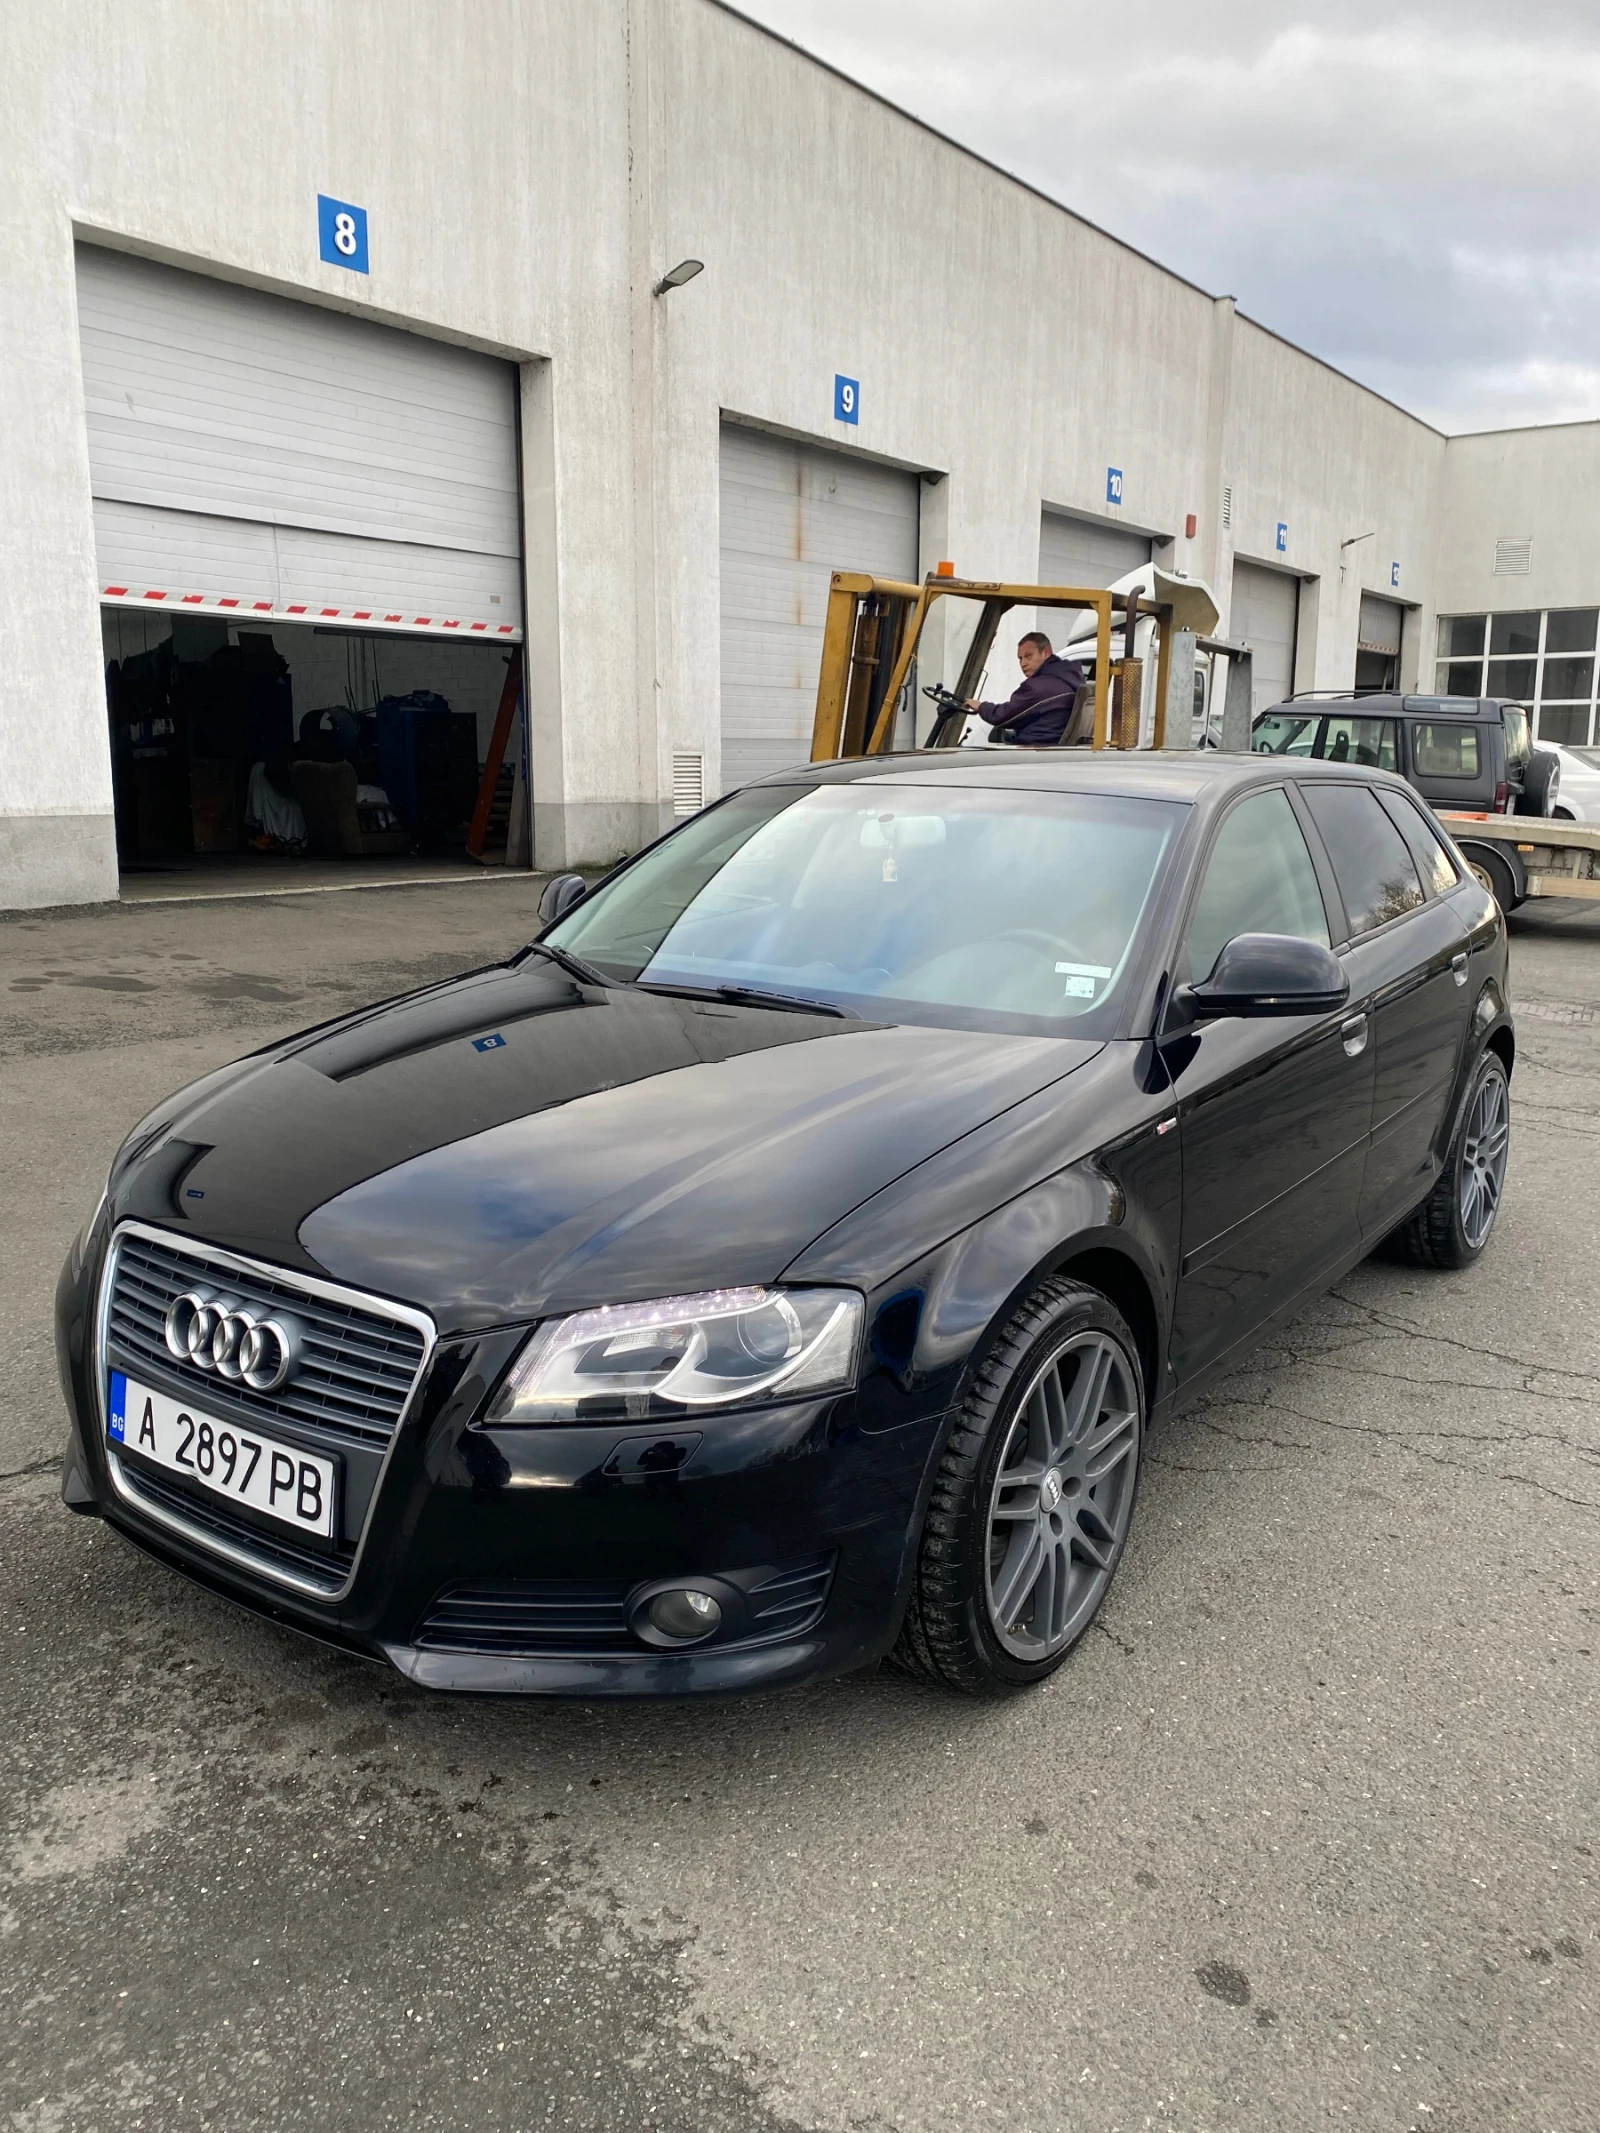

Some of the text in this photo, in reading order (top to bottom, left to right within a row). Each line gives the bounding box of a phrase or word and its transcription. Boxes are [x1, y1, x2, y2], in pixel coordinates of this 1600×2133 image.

[335, 212, 357, 256] 8
[842, 384, 855, 414] 9
[1110, 474, 1122, 498] 10
[1279, 528, 1287, 546] 11
[112, 1413, 124, 1432] BG
[139, 1396, 323, 1521] A 2897 PB
